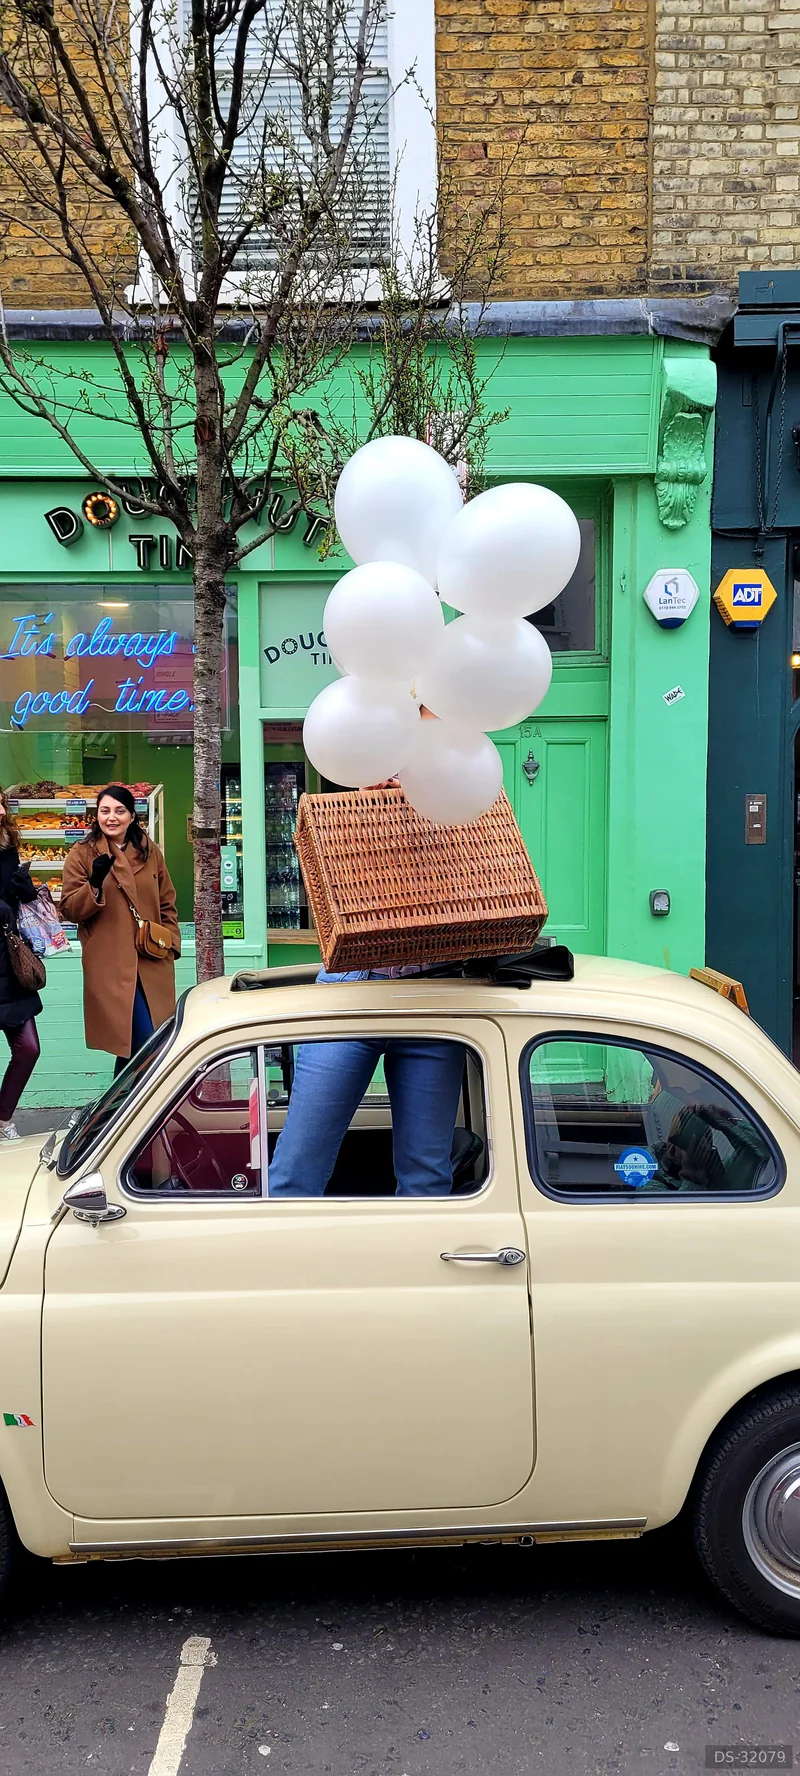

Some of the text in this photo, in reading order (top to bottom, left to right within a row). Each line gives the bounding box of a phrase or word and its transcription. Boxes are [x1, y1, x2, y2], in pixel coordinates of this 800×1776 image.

[658, 597, 686, 605] LanTec
[733, 588, 762, 603] ADT
[0, 612, 178, 668] It's always
[11, 678, 95, 725] good
[518, 725, 542, 738] 15A
